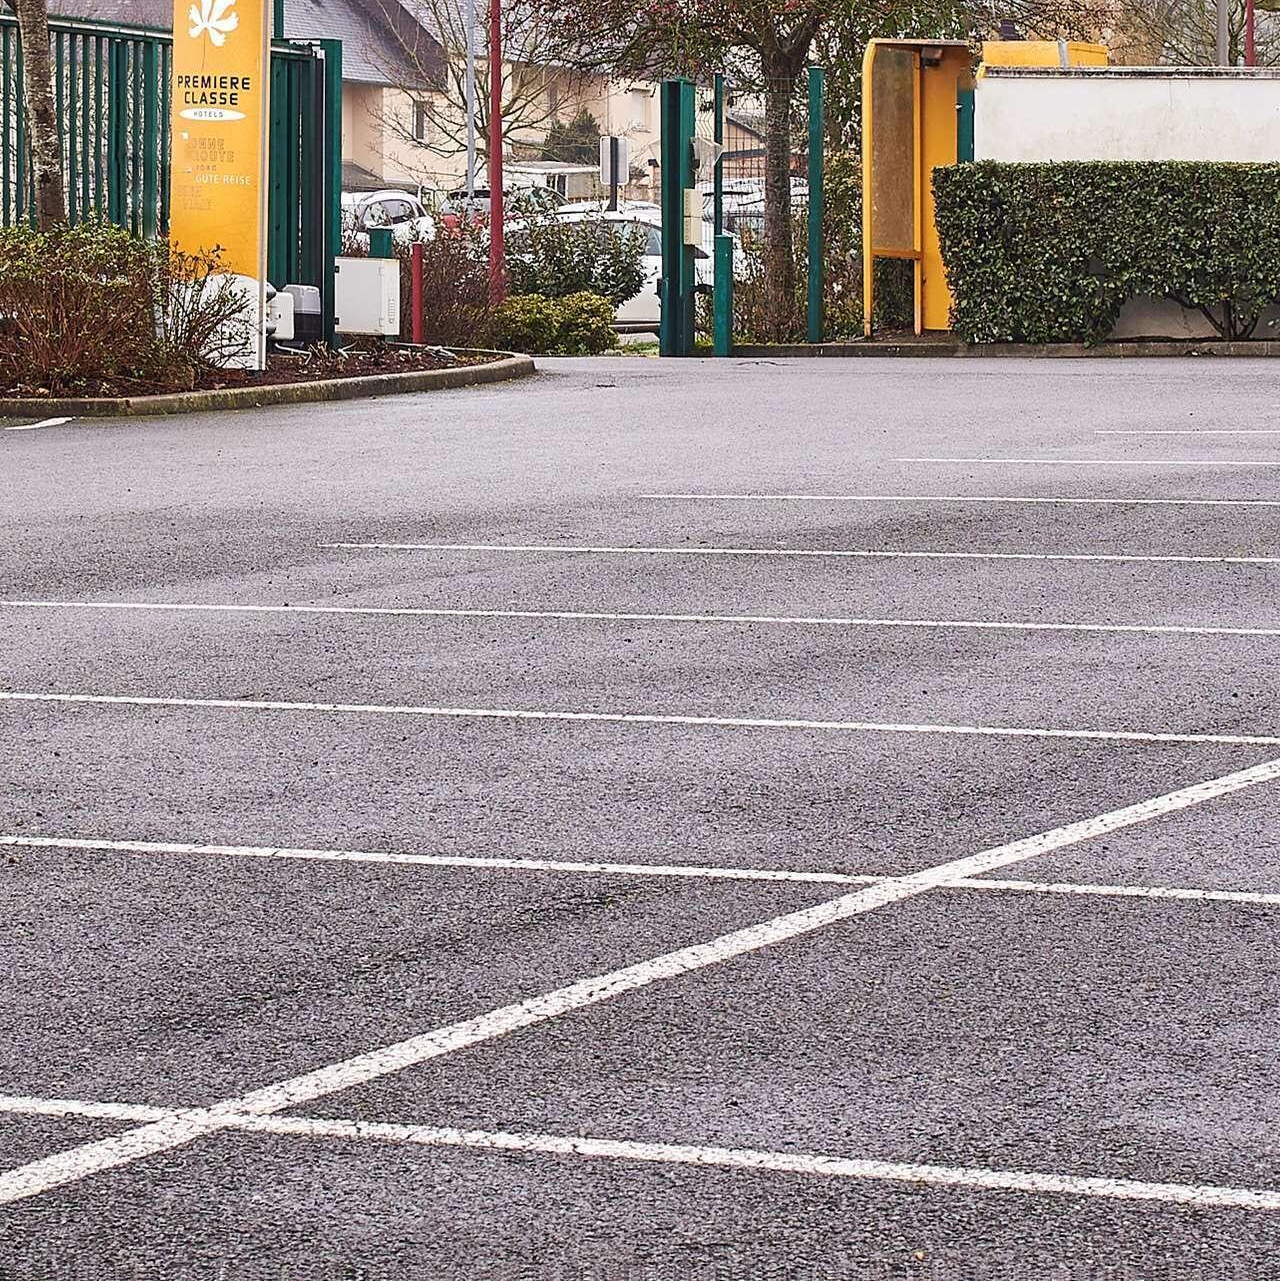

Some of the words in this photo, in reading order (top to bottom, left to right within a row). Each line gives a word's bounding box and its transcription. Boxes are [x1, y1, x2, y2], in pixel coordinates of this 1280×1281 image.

[177, 75, 250, 90] PREMIERE
[184, 91, 238, 105] CLASSE
[195, 174, 219, 183] GUTE
[223, 175, 251, 186] REISE
